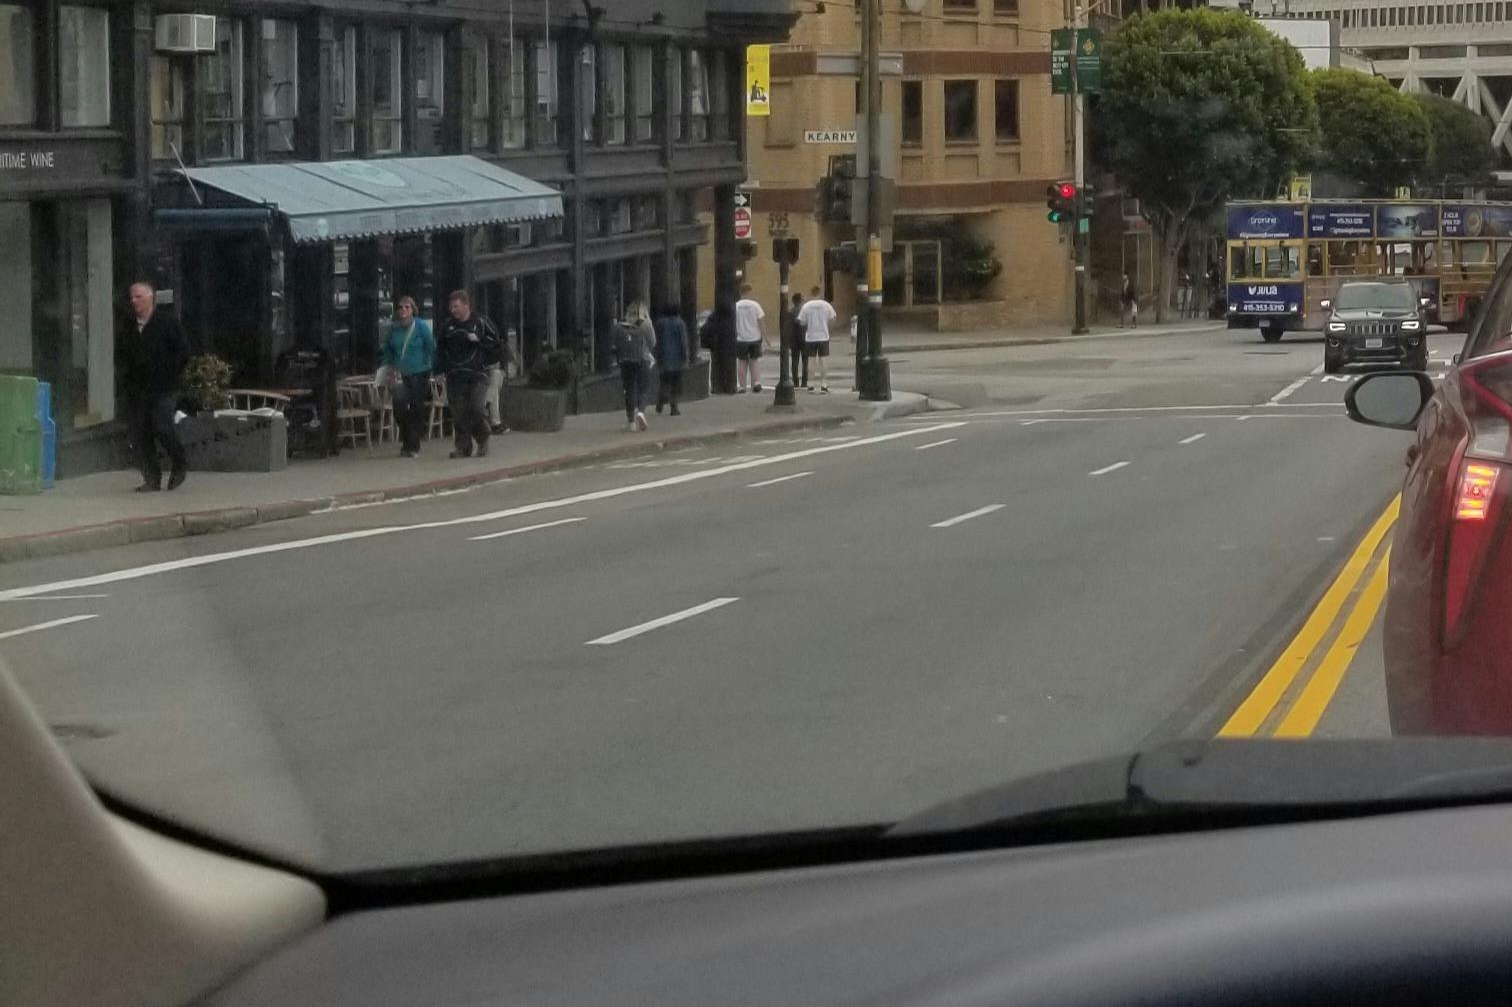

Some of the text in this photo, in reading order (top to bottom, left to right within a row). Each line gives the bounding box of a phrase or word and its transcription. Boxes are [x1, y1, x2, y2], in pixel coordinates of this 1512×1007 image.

[808, 132, 855, 142] KEARNY
[0, 152, 54, 169] ITIME WINE
